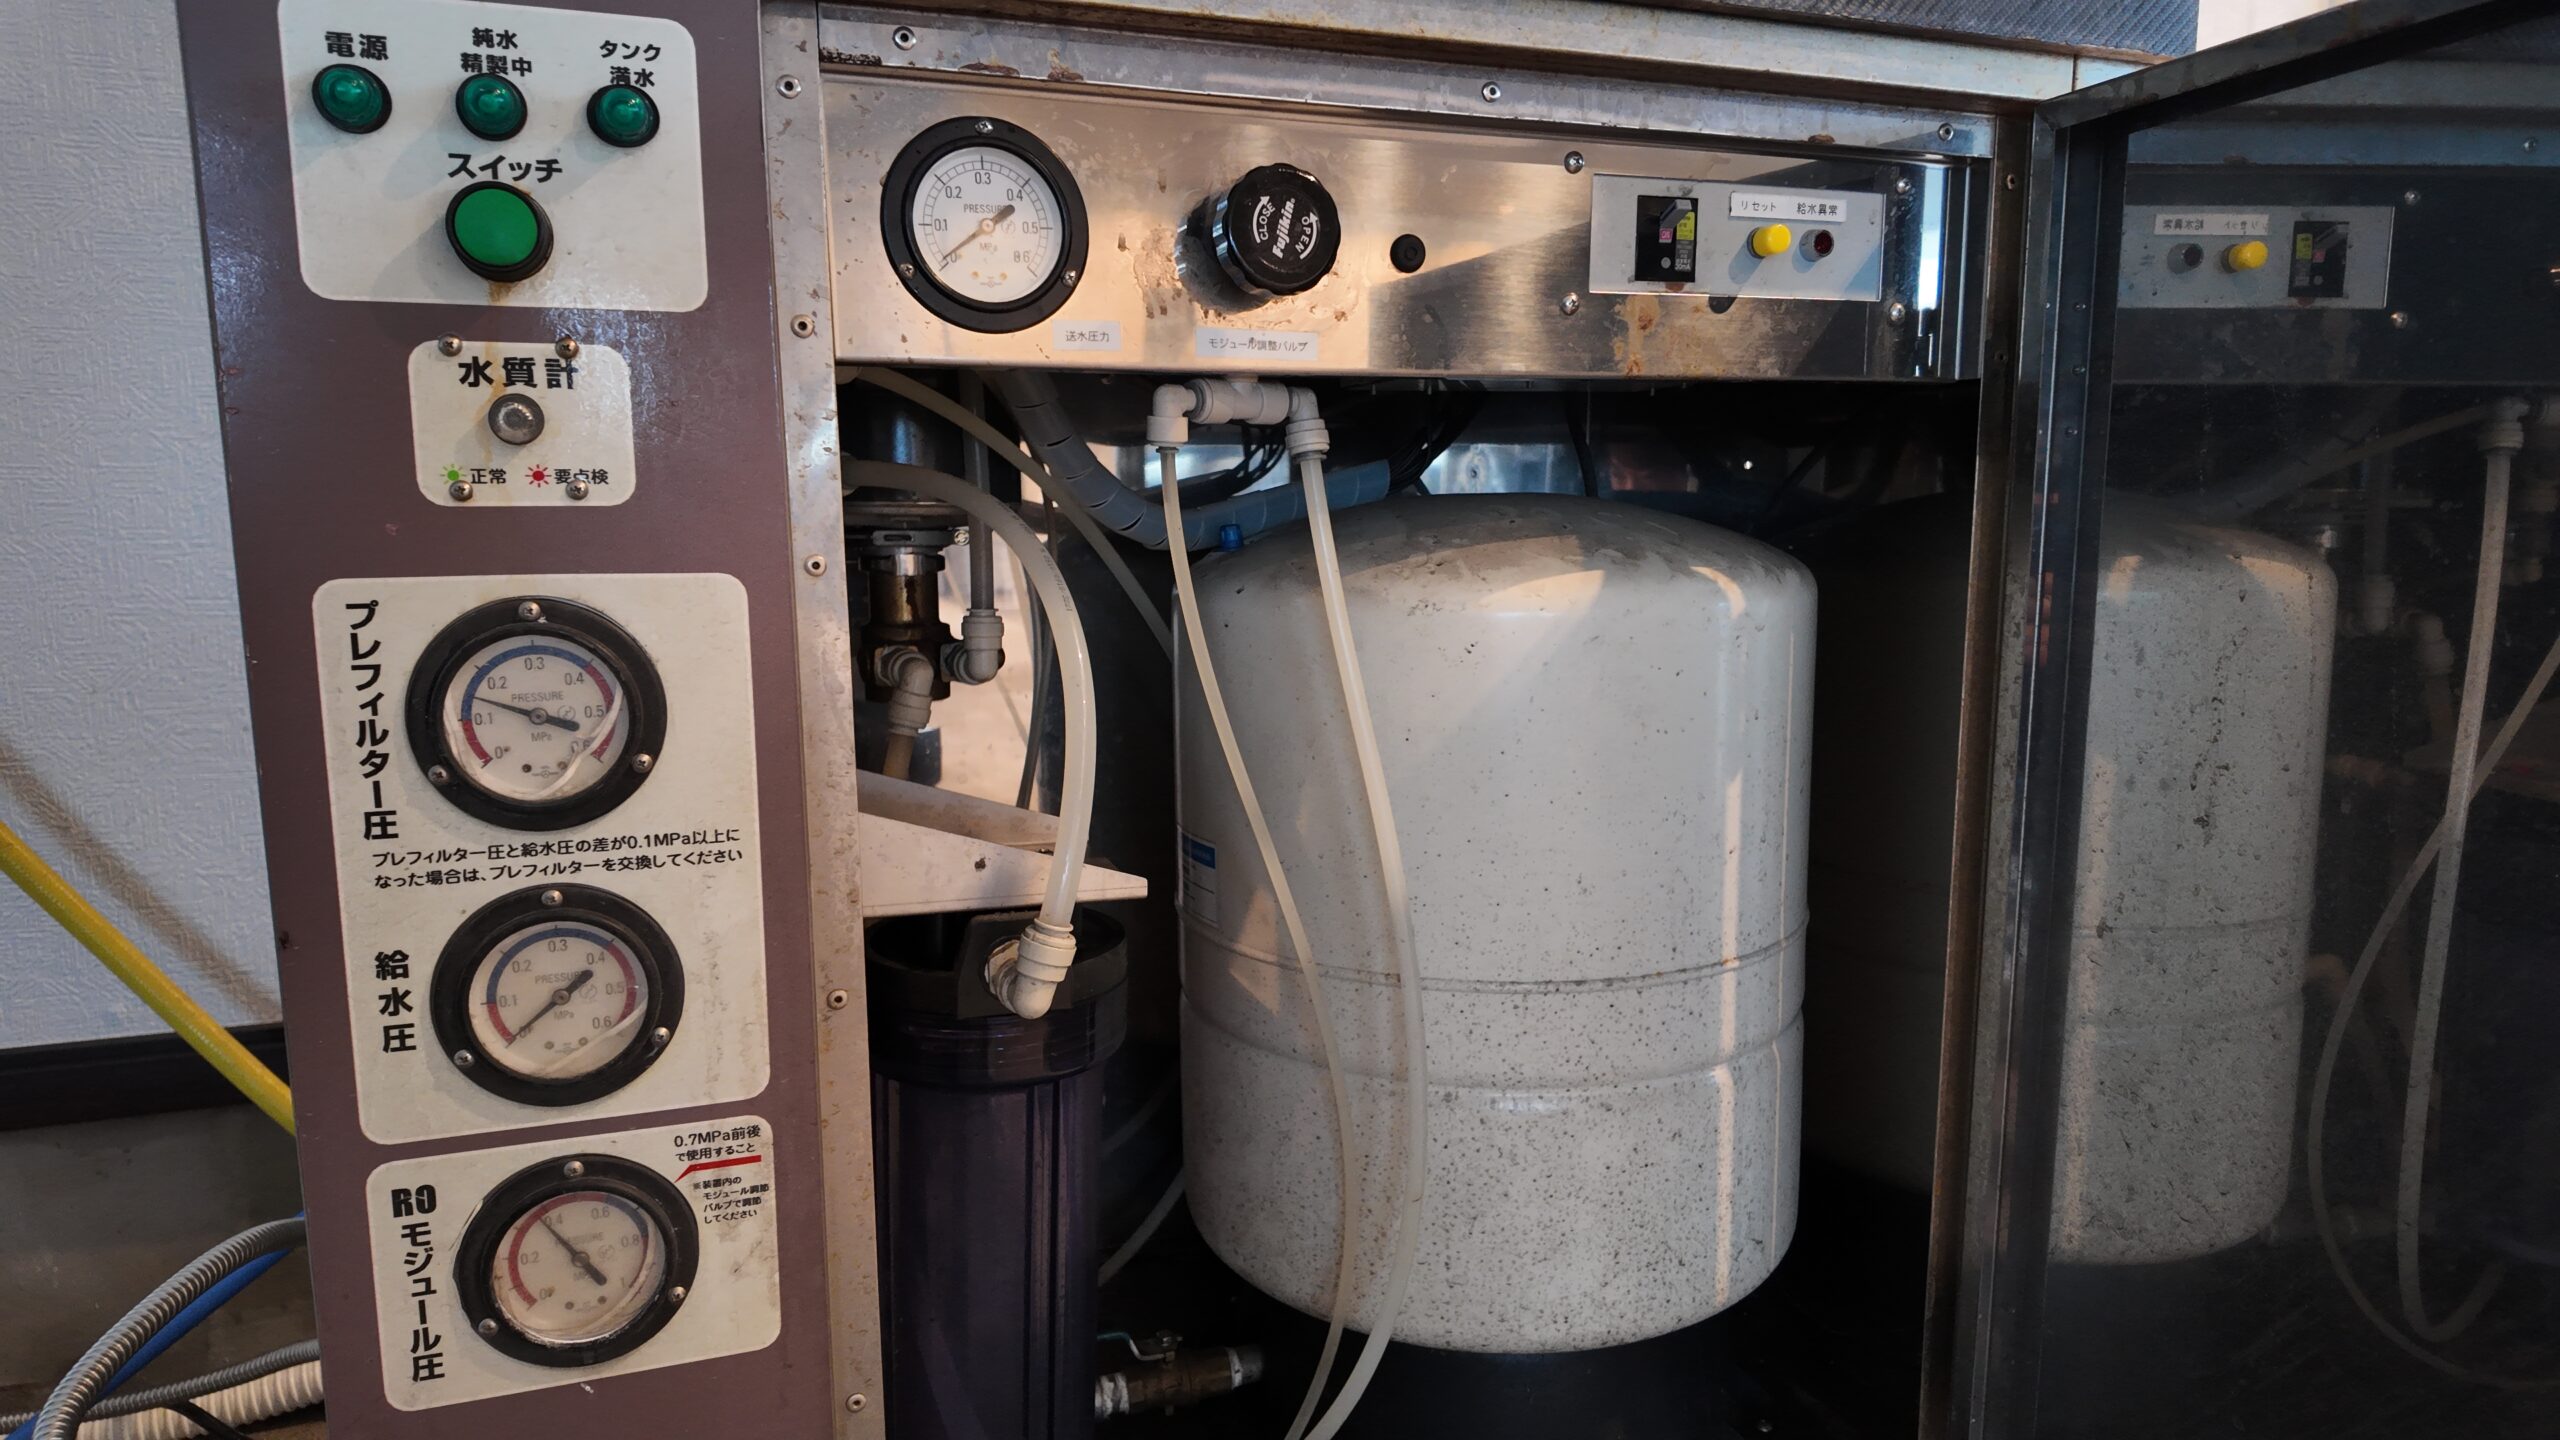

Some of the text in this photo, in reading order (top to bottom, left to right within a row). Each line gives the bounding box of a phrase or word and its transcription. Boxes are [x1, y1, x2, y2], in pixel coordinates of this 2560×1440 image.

[324, 31, 390, 61] 電源
[472, 27, 519, 50] 純水
[599, 40, 662, 62] タンク
[461, 52, 533, 77] 精製中
[609, 66, 656, 88] 満水
[447, 152, 563, 183] スイッチ
[974, 171, 992, 185] 0.3
[945, 185, 962, 200] 0.2
[1006, 188, 1024, 202] 0.4
[963, 203, 1008, 215] PRESSUR
[1741, 200, 1777, 212] リセット
[1796, 202, 1838, 217] 給水異常
[934, 218, 948, 232] 0.1
[1022, 221, 1039, 235] 0.5
[1259, 201, 1276, 241] CLOSE
[1295, 216, 1312, 253] OPEN
[1065, 330, 1110, 343] 送水圧力
[457, 355, 578, 390] 水質計
[469, 467, 507, 485] 正常
[553, 467, 609, 486] 要点検
[524, 656, 545, 671] 0.3
[487, 676, 508, 690] 0.2
[564, 672, 585, 686] 0.4
[511, 690, 564, 702] PRESSURE
[474, 712, 493, 726] 0.1
[584, 705, 604, 718] 0.5
[345, 599, 399, 841] プレフィルター圧
[547, 939, 568, 953] 0.3
[586, 951, 606, 966] 0.4
[511, 959, 532, 974] 0.2
[534, 971, 585, 985] PRESSUR
[605, 982, 625, 996] 0.5
[374, 949, 417, 1054] 給水圧
[499, 995, 518, 1008] 0.1
[592, 1016, 612, 1030] 0.6
[674, 1124, 761, 1148] 0.7MPa前後
[675, 1142, 756, 1162] で使用すること
[543, 1213, 564, 1228] 0.4
[591, 1207, 610, 1220] 0.6
[704, 1209, 758, 1225] してください
[620, 1234, 640, 1248] 0.8
[520, 1251, 540, 1266] 0.2
